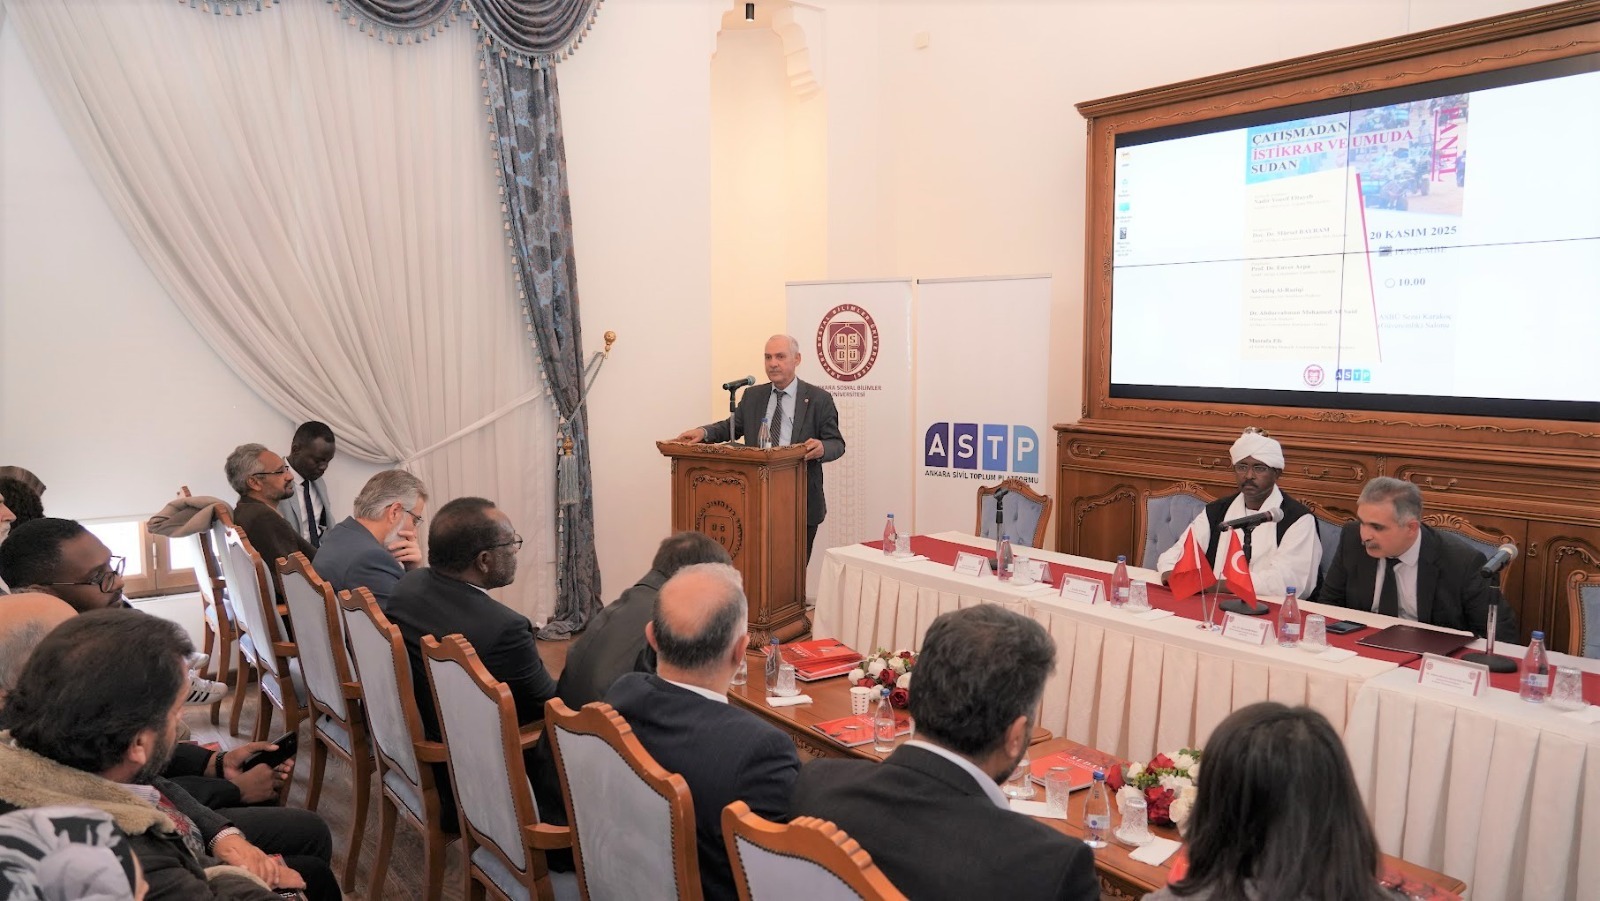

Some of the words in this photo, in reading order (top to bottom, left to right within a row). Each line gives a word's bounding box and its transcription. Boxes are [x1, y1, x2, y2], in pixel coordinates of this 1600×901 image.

[1252, 121, 1349, 145] ÇATIŞMADAN
[1253, 141, 1323, 160] İSTİKRAR
[1328, 138, 1347, 150] VE
[1352, 130, 1413, 147] UMUDA
[1251, 160, 1298, 174] SUDAN
[1370, 231, 1382, 240] 20
[1385, 228, 1427, 239] KASIM
[1431, 226, 1457, 236] 2025
[1399, 278, 1426, 286] 10.00
[928, 432, 1035, 461] ASTP
[924, 470, 951, 478] ANKARA
[952, 471, 969, 479] SİVİL
[970, 473, 996, 481] TOPLUM
